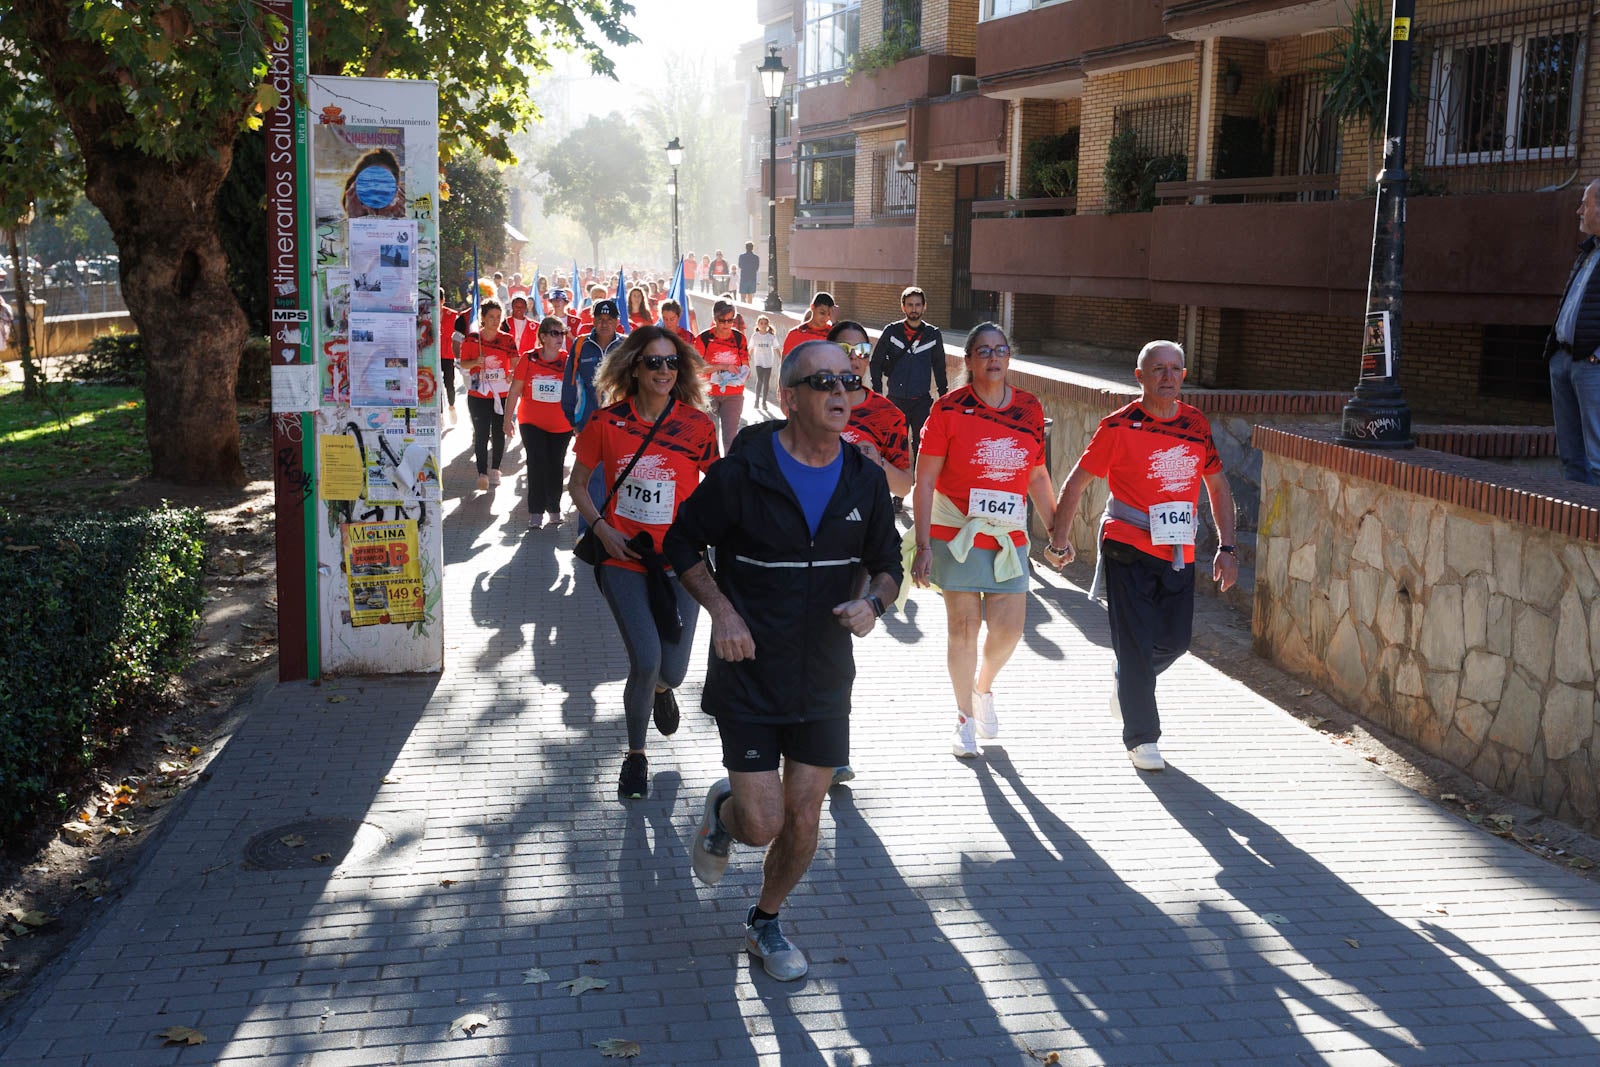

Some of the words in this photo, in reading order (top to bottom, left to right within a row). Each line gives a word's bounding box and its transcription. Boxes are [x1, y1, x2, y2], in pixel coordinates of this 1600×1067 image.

[296, 28, 304, 53] Bicha
[296, 58, 304, 68] la
[296, 74, 304, 83] de
[380, 116, 430, 126] Ayuntamiento
[274, 311, 308, 320] MPS
[539, 384, 555, 392] 852
[978, 448, 1024, 458] carrera
[1151, 458, 1196, 470] carrera
[626, 484, 660, 504] 1781
[979, 500, 1015, 515] 1647
[1160, 511, 1190, 525] 1640
[389, 542, 410, 565] B
[388, 588, 408, 600] 149
[413, 587, 421, 598] €
